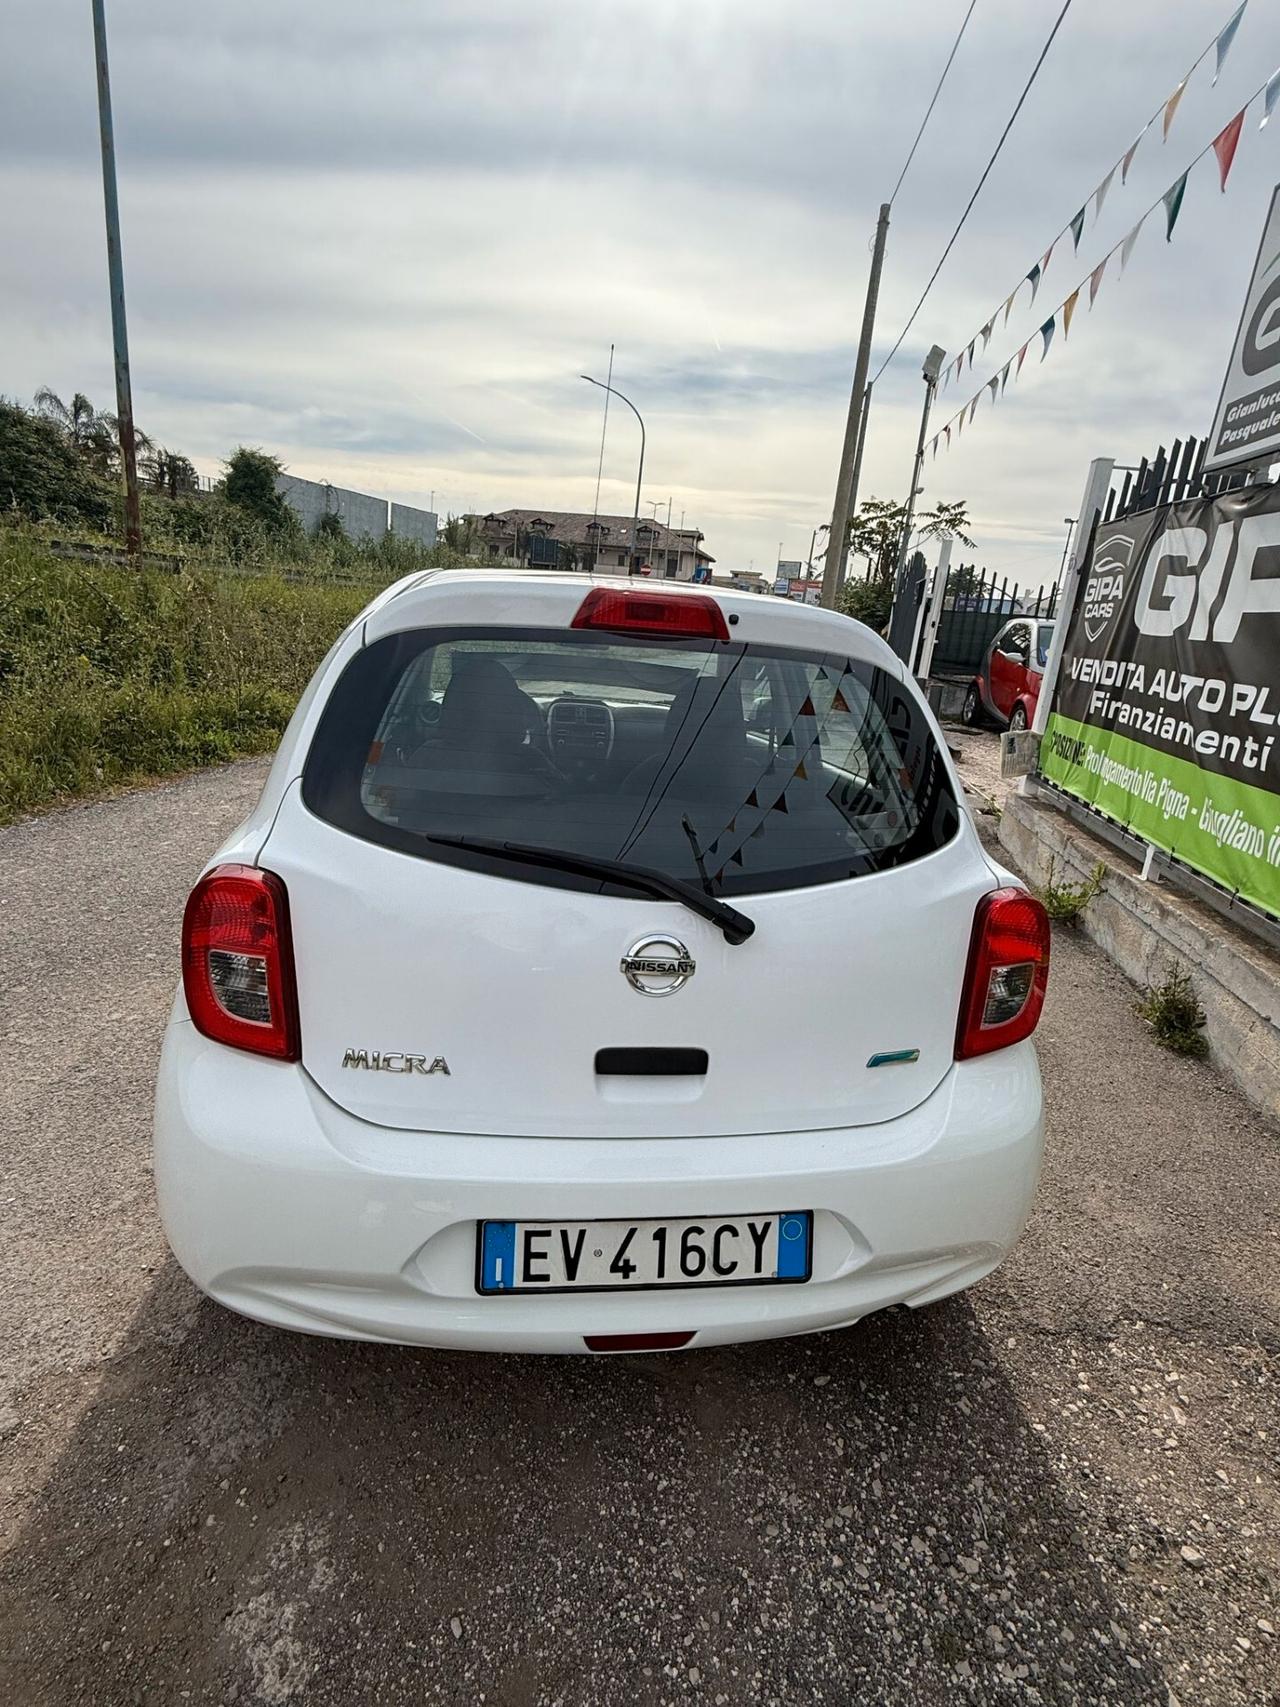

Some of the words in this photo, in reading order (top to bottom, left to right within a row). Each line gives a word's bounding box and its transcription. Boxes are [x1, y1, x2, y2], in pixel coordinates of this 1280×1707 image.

[1220, 411, 1280, 445] Pasquale
[1084, 574, 1124, 603] GIPA
[1084, 602, 1115, 618] CARS
[1071, 657, 1146, 693] VENDITA
[1147, 668, 1227, 714] AUTO
[1229, 683, 1280, 726] PL
[1141, 770, 1158, 804] Via
[1155, 777, 1190, 820] Pigna
[627, 961, 689, 973] NISSAN
[342, 1048, 451, 1076] MICRA
[522, 1229, 587, 1283] EV
[609, 1221, 772, 1279] 416CY
